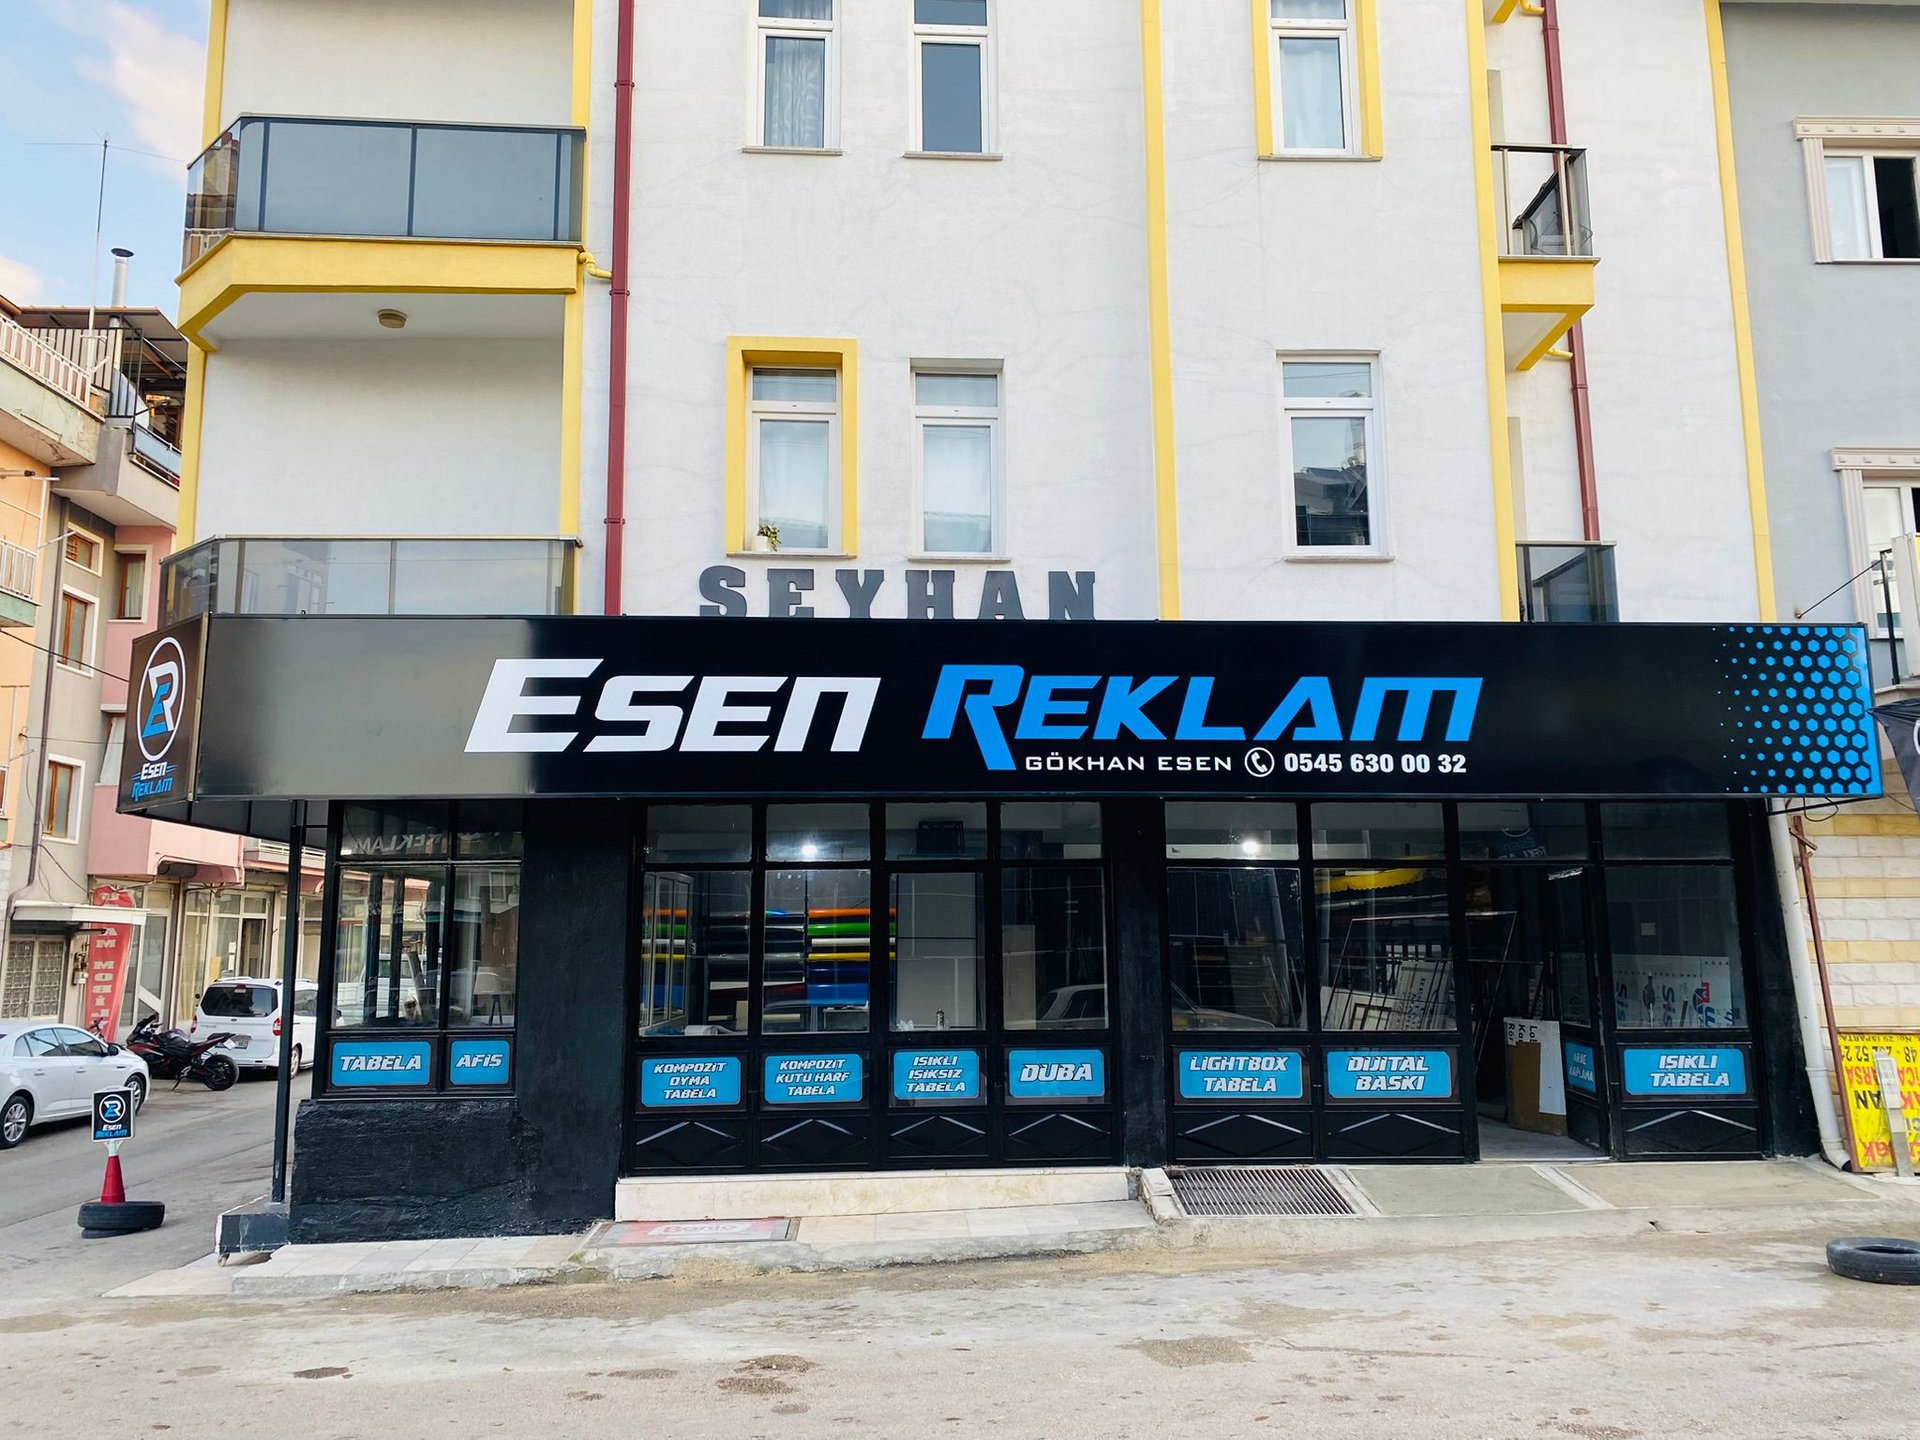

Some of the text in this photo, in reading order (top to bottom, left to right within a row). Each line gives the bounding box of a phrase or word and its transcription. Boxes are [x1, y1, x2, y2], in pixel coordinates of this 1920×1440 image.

[699, 565, 1097, 621] SEYHAN
[1025, 752, 1467, 773] GÖKHAN ESEN 0545 630 00 32
[340, 1055, 421, 1071] TABELA
[654, 1062, 727, 1074] KOMPOZİT
[779, 1059, 846, 1071] KOMPOZİT
[776, 1072, 849, 1084] KUTU HARF
[1020, 1063, 1092, 1082] DUBA
[669, 1075, 711, 1086] OYMA
[1203, 1077, 1277, 1092] TABELA
[1355, 1075, 1425, 1091] BASKI
[1651, 1073, 1730, 1087] TABELA
[663, 1088, 717, 1099] TABELA
[787, 1085, 836, 1097] TABELA
[905, 1082, 966, 1093] TABELA
